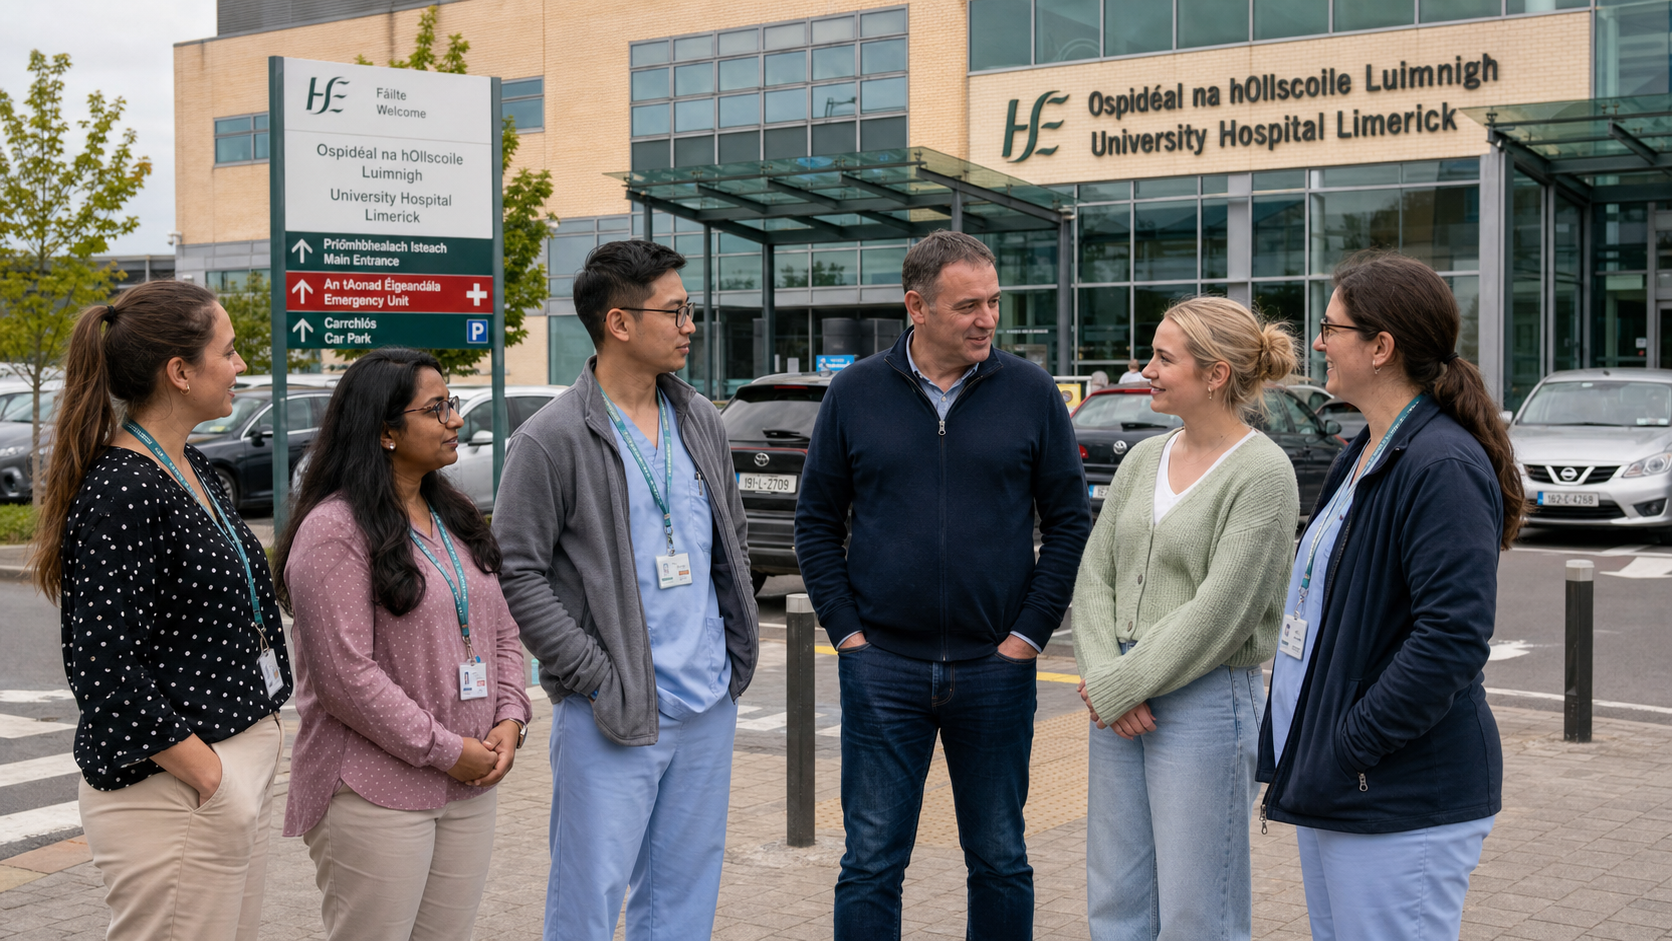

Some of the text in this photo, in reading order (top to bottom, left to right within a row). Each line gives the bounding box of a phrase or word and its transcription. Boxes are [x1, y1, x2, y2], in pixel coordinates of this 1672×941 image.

[376, 87, 407, 101] Fáilte
[1088, 53, 1499, 120] Ospidéal na hOllscoile Luimnigh
[376, 104, 427, 119] Welcome
[1091, 102, 1458, 157] University Hospital Limerick
[316, 143, 464, 166] Ospidéal na hOllscoile
[362, 165, 423, 184] Luimnigh
[330, 188, 452, 208] University Hospital
[365, 208, 421, 224] Limerick
[411, 241, 447, 254] Isteach
[323, 253, 400, 267] Main Entrance
[323, 278, 340, 290] An
[343, 279, 382, 291] tAonad
[324, 293, 409, 308] Emergency Unit
[324, 316, 377, 330] Carrchlós
[324, 332, 372, 345] Car Park
[472, 323, 484, 341] P
[744, 477, 790, 491] 191-L-2709
